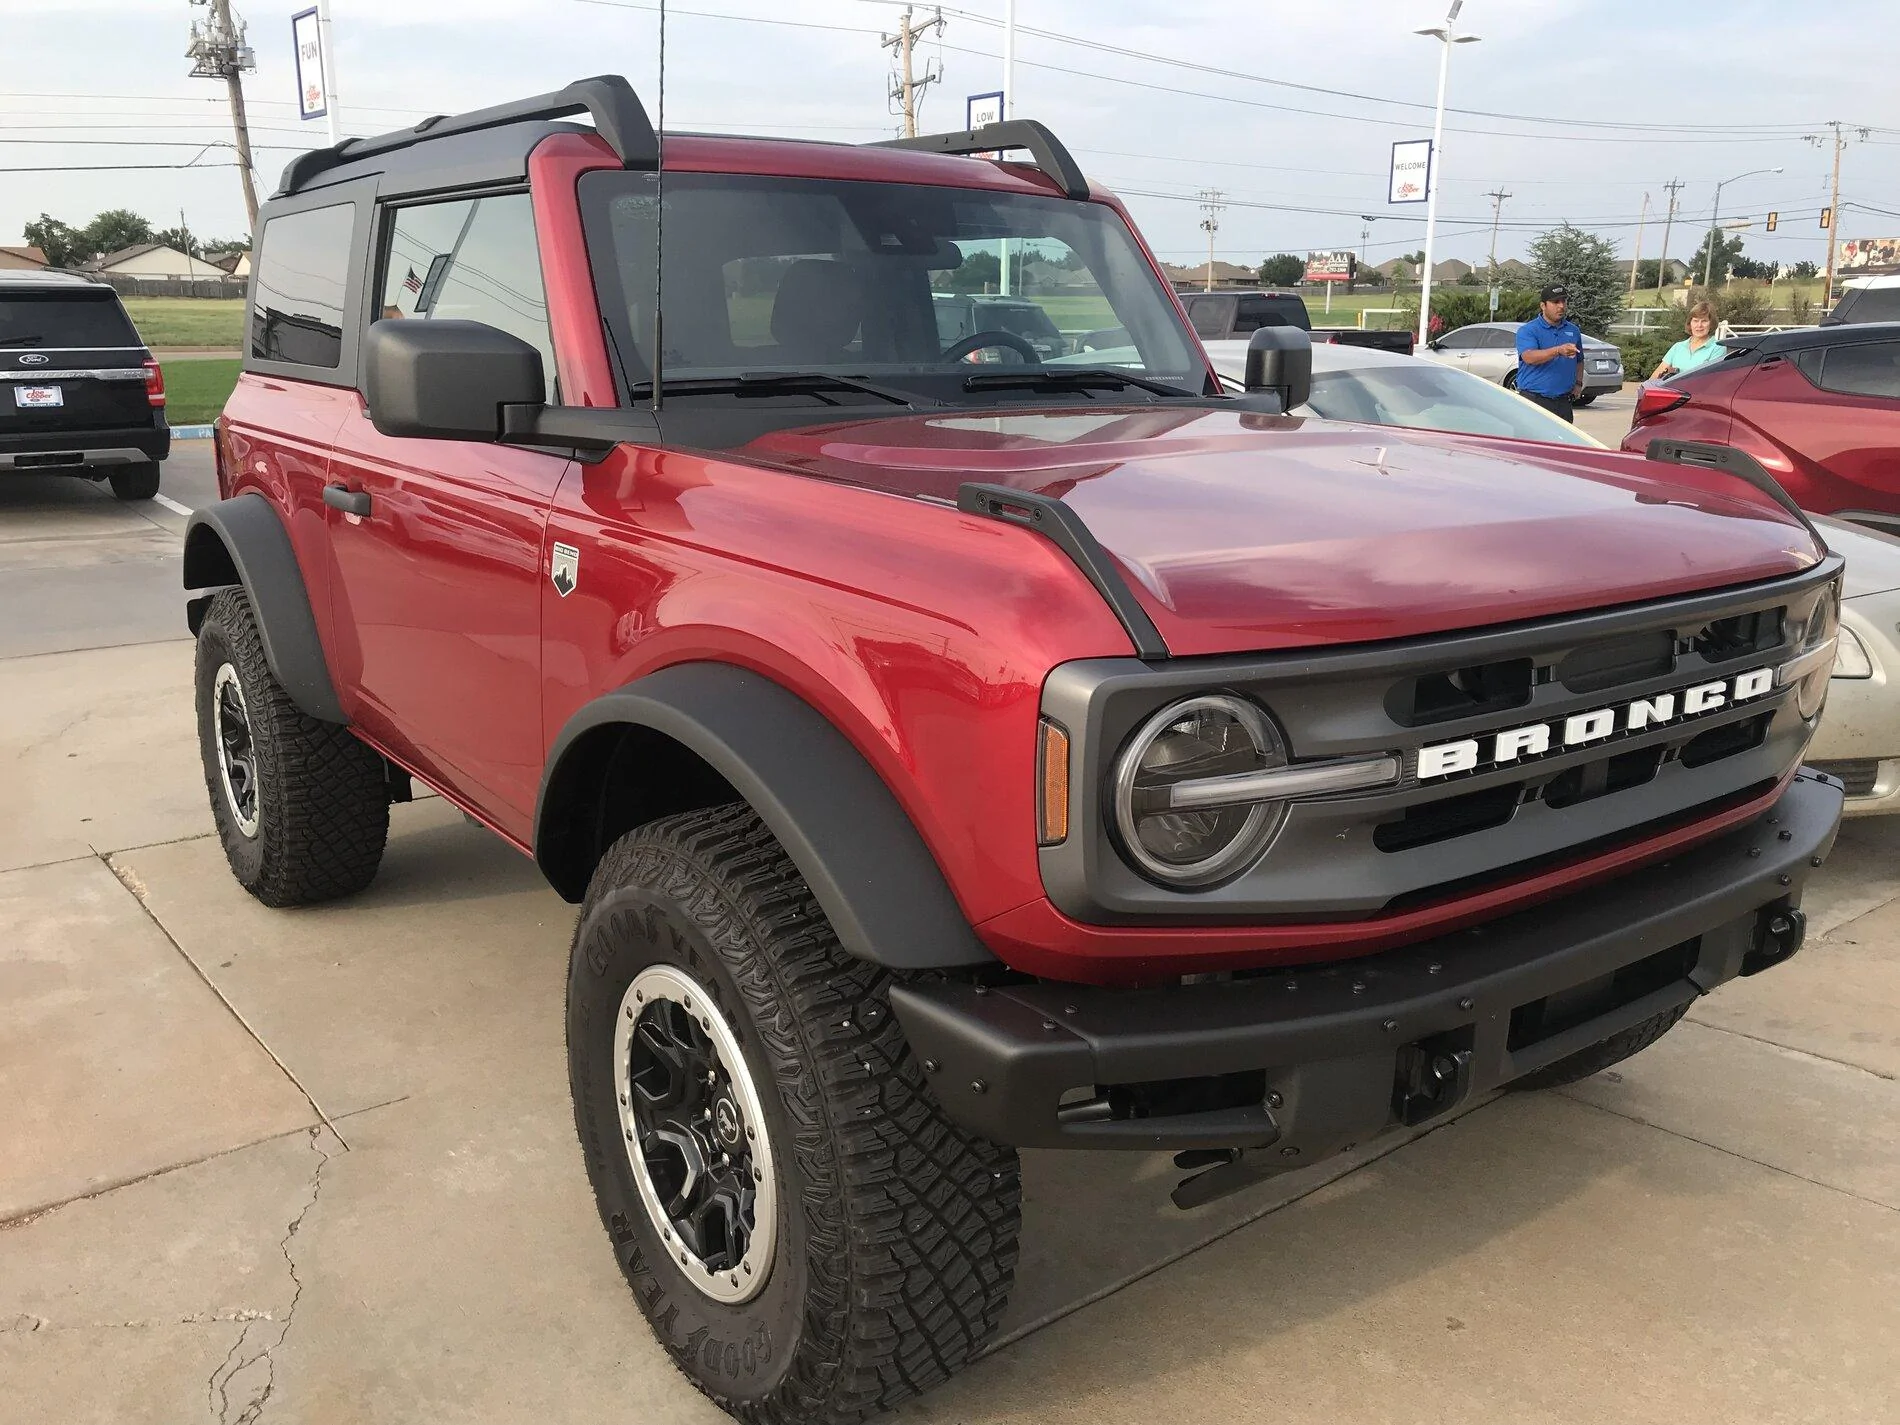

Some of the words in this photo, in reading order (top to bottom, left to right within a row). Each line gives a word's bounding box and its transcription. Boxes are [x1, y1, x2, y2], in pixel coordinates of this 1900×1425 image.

[301, 41, 318, 61] FUN
[976, 111, 994, 123] LOW
[1395, 161, 1426, 171] WELCOME
[1329, 253, 1348, 262] AAA
[1417, 667, 1773, 780] BRONCO
